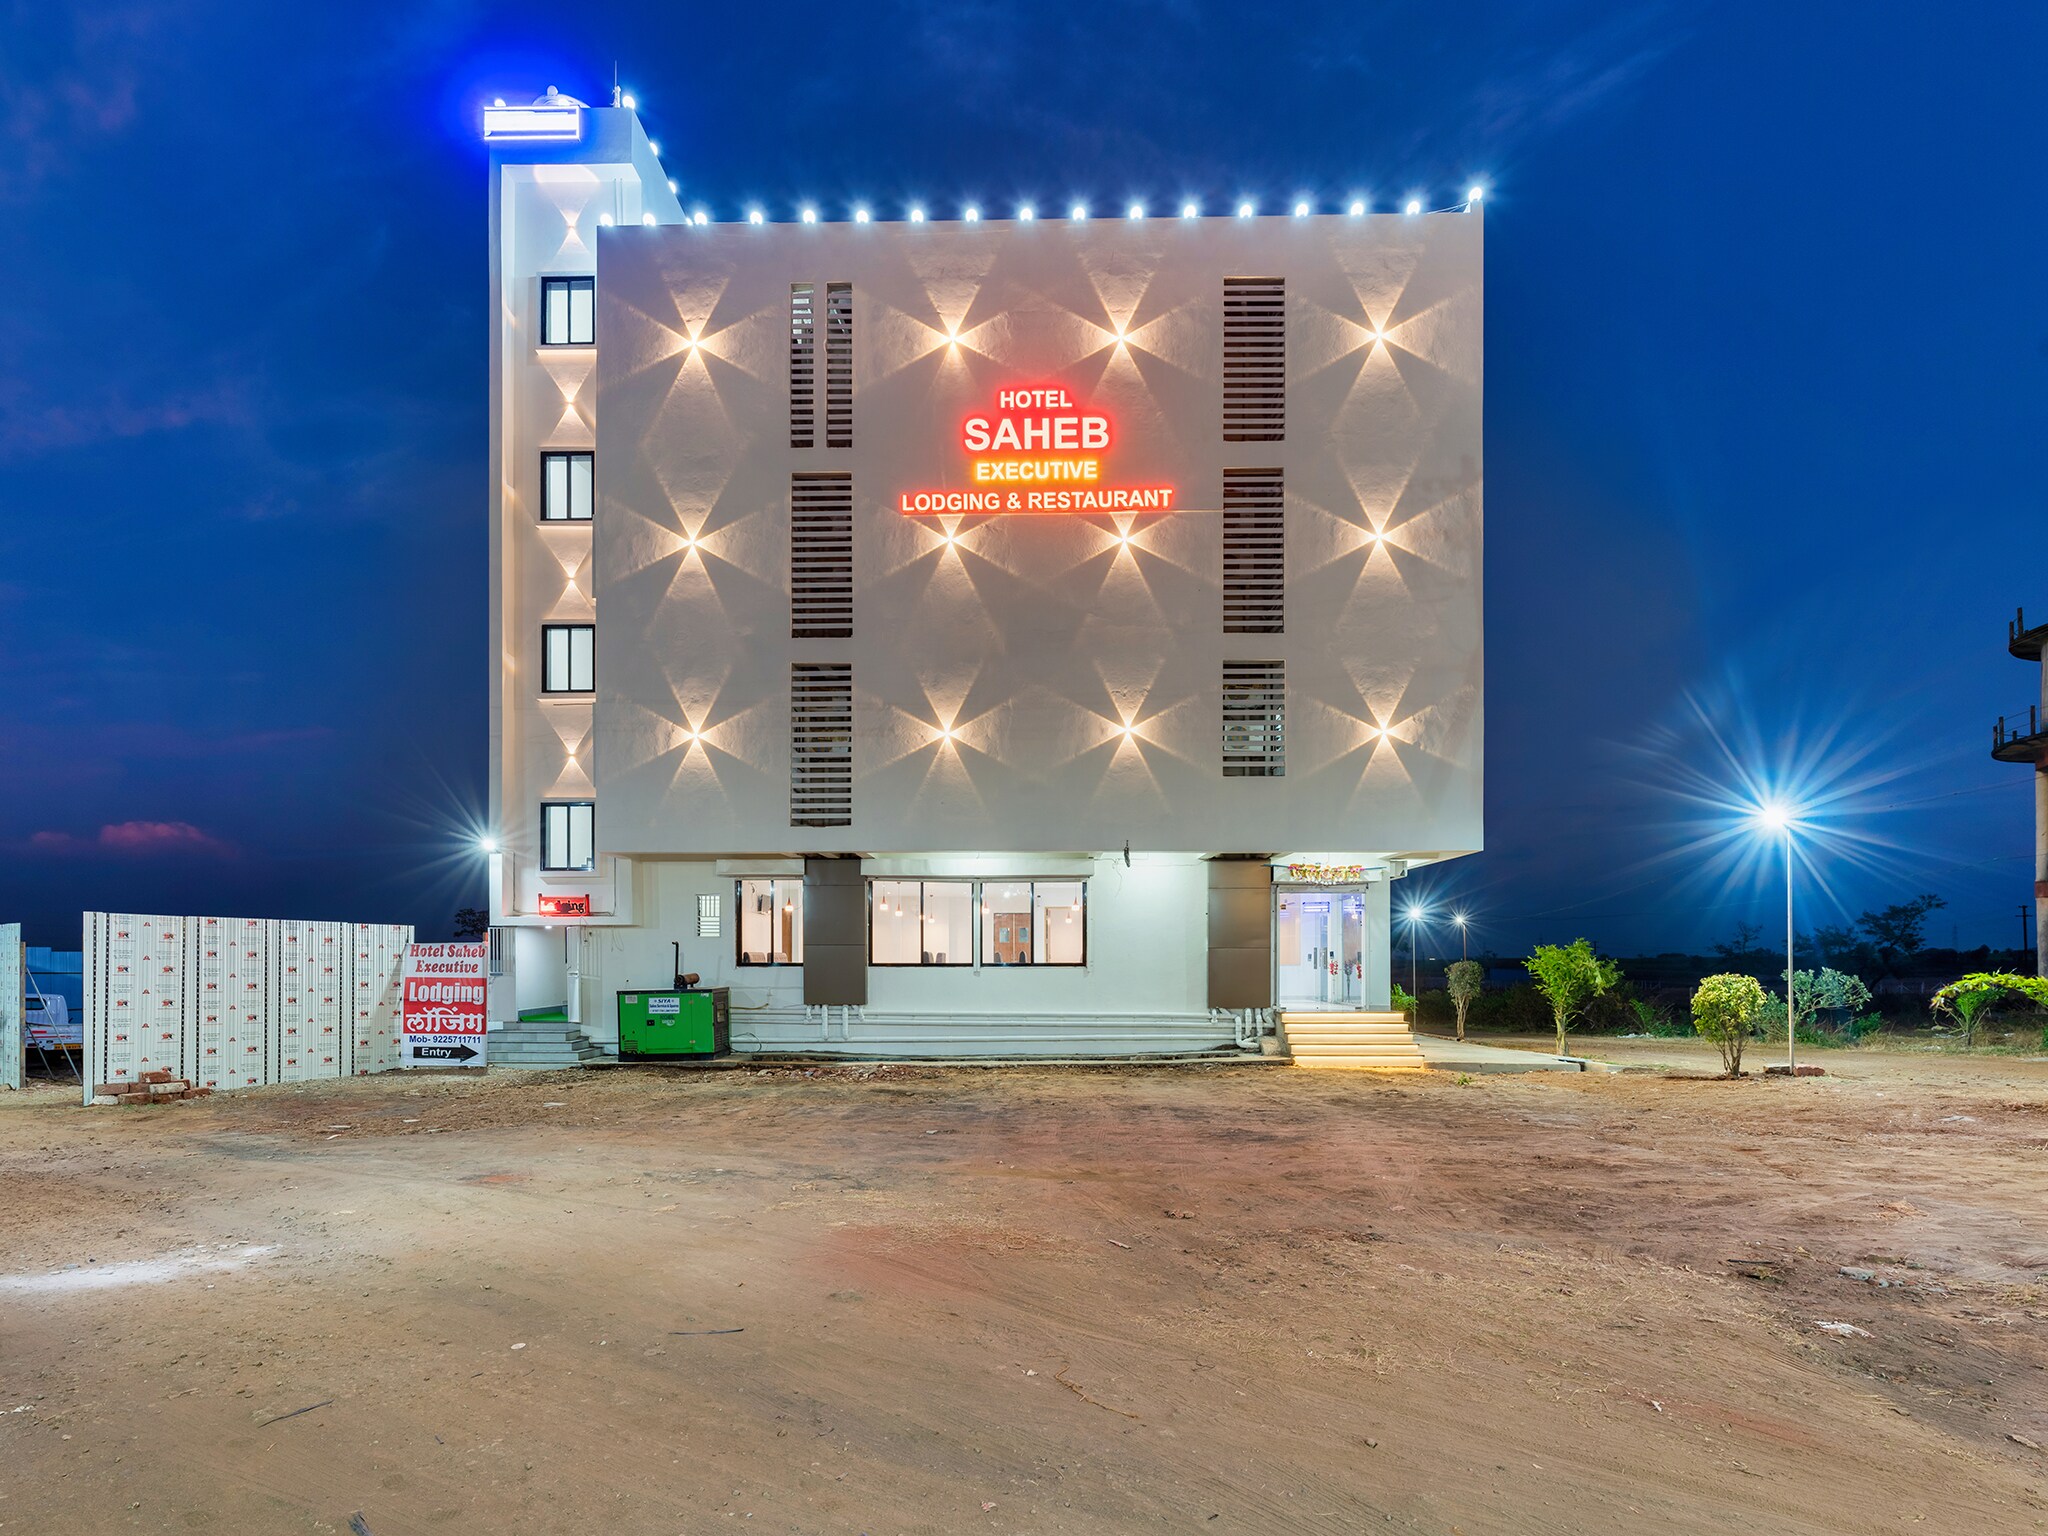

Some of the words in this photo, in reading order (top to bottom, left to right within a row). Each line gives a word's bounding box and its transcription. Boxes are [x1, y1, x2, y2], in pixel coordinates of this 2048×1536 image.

[1000, 390, 1072, 408] HOTEL
[964, 417, 1109, 451] SAHEB
[976, 461, 1098, 480] EXECUTIVE
[902, 492, 1000, 511] LODGING
[1006, 491, 1021, 509] &
[1028, 489, 1173, 509] RESTAURANT
[410, 944, 444, 958] Hotel
[447, 944, 485, 958] Saheb
[415, 959, 478, 973] Executive
[409, 981, 485, 1005] Lodging
[406, 1007, 485, 1033] लॉजिंग
[409, 1035, 431, 1044] Mob-
[433, 1035, 481, 1044] 9225711711
[421, 1047, 452, 1058] Entry
